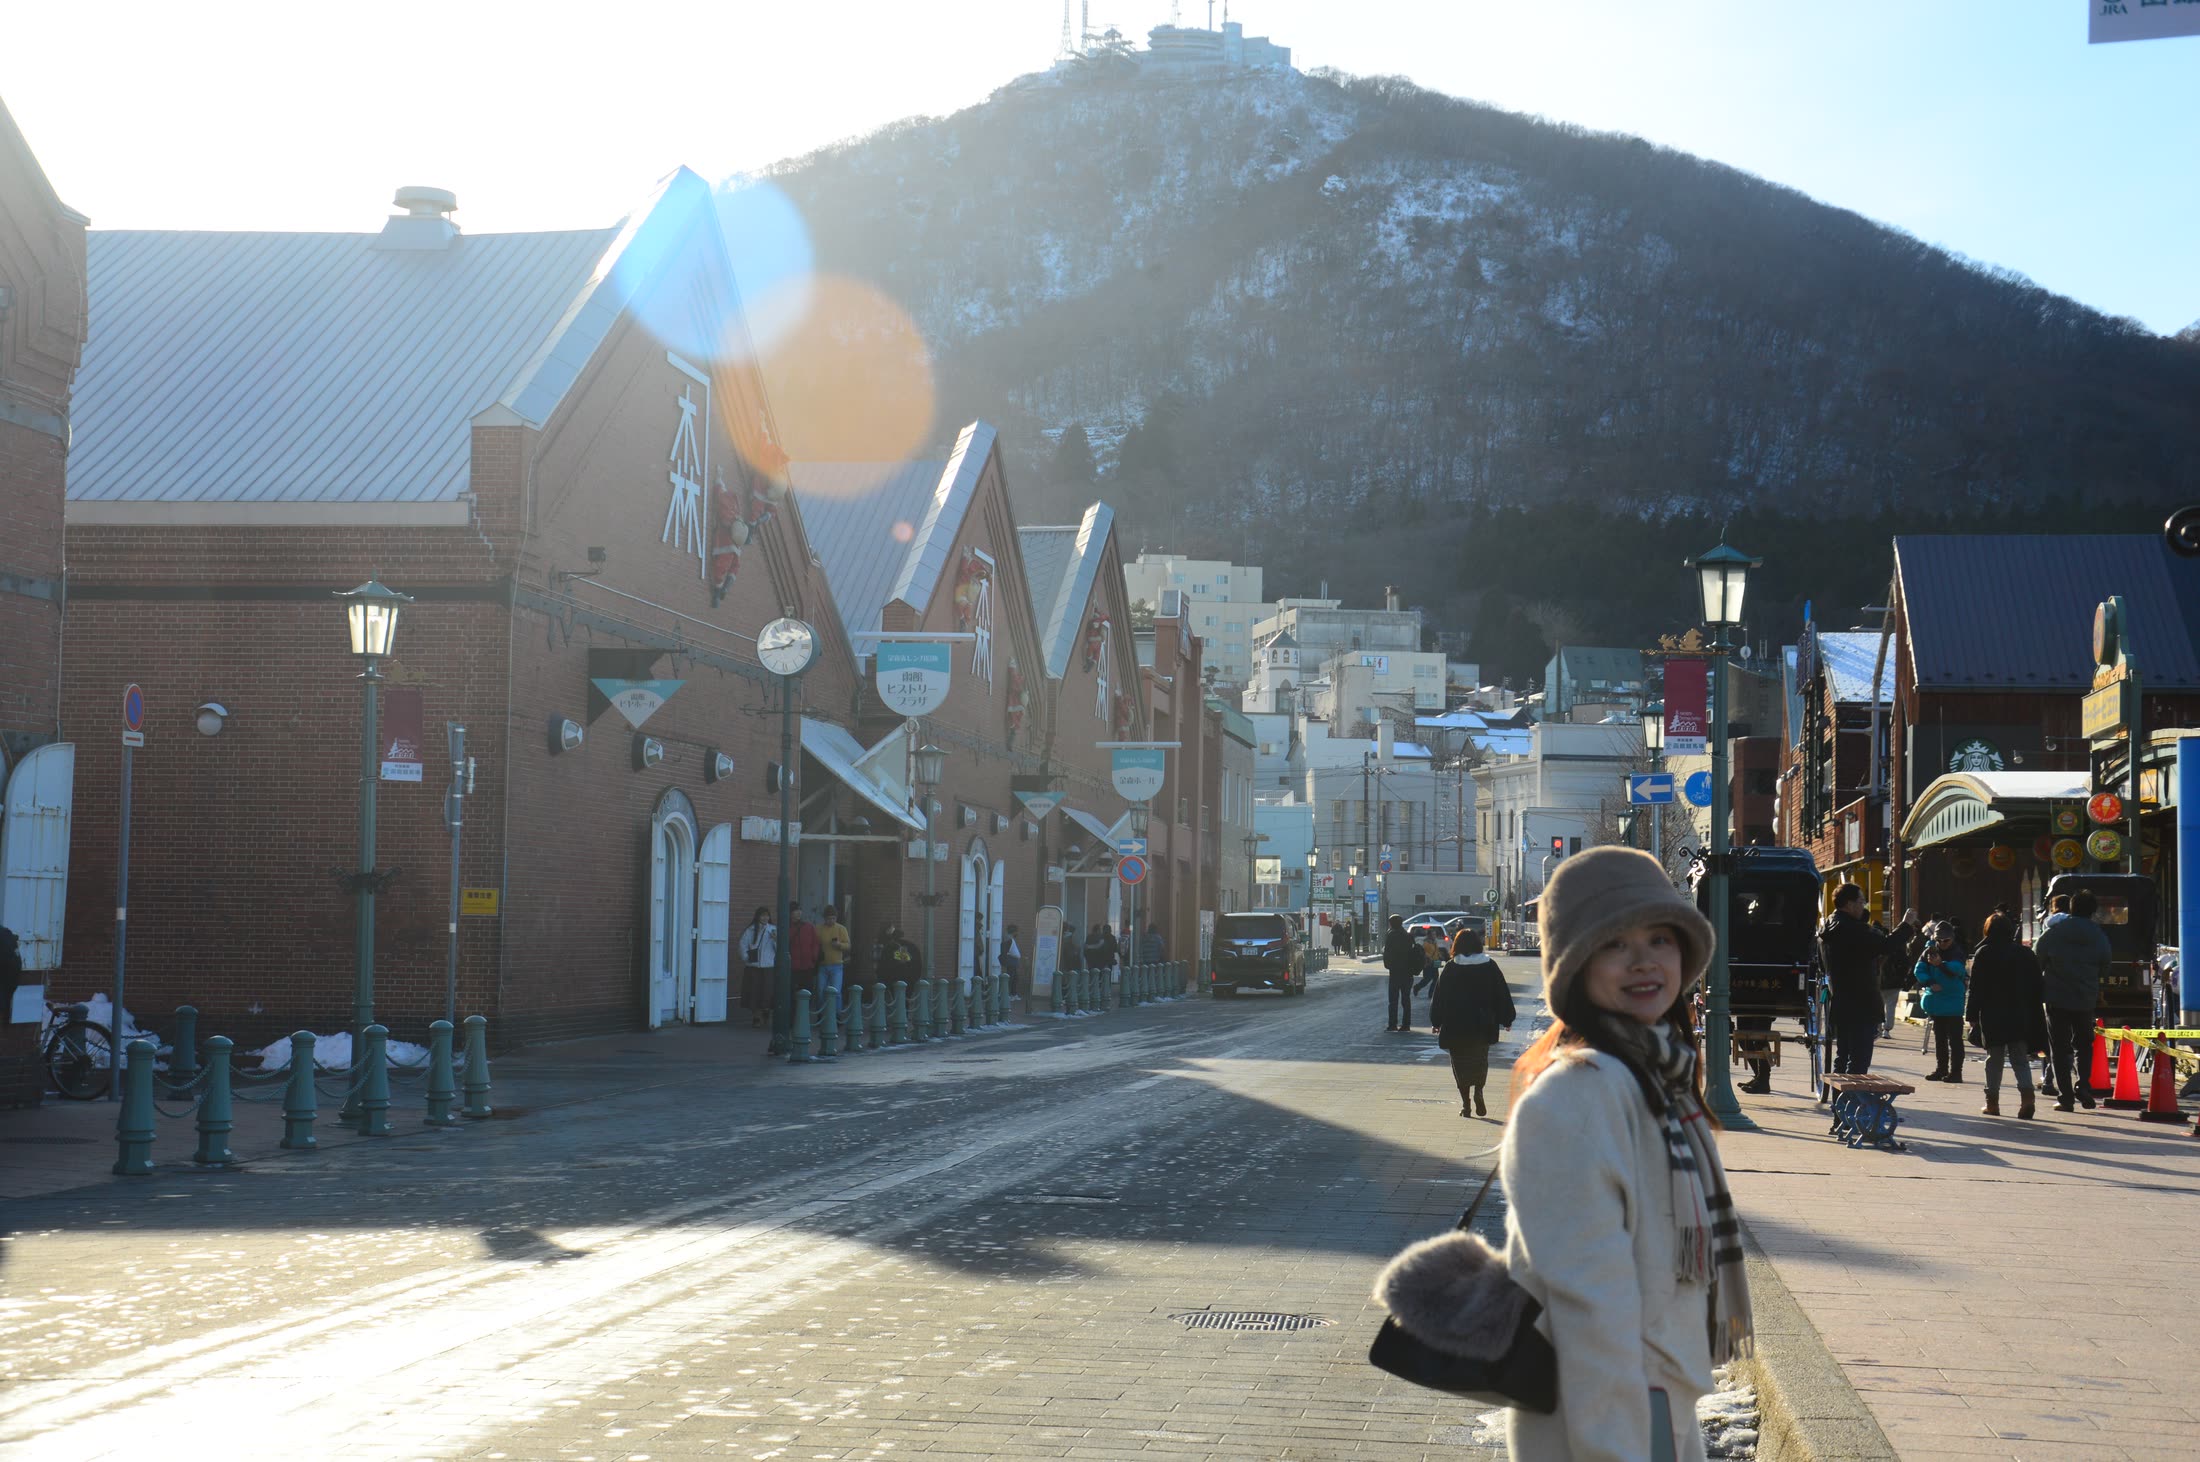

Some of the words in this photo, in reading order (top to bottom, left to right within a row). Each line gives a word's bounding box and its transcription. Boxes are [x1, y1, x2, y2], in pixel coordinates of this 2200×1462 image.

[2100, 4, 2128, 15] JRA
[902, 671, 923, 682] 函館
[887, 684, 938, 694] ヒストリー
[1489, 890, 1496, 901] P
